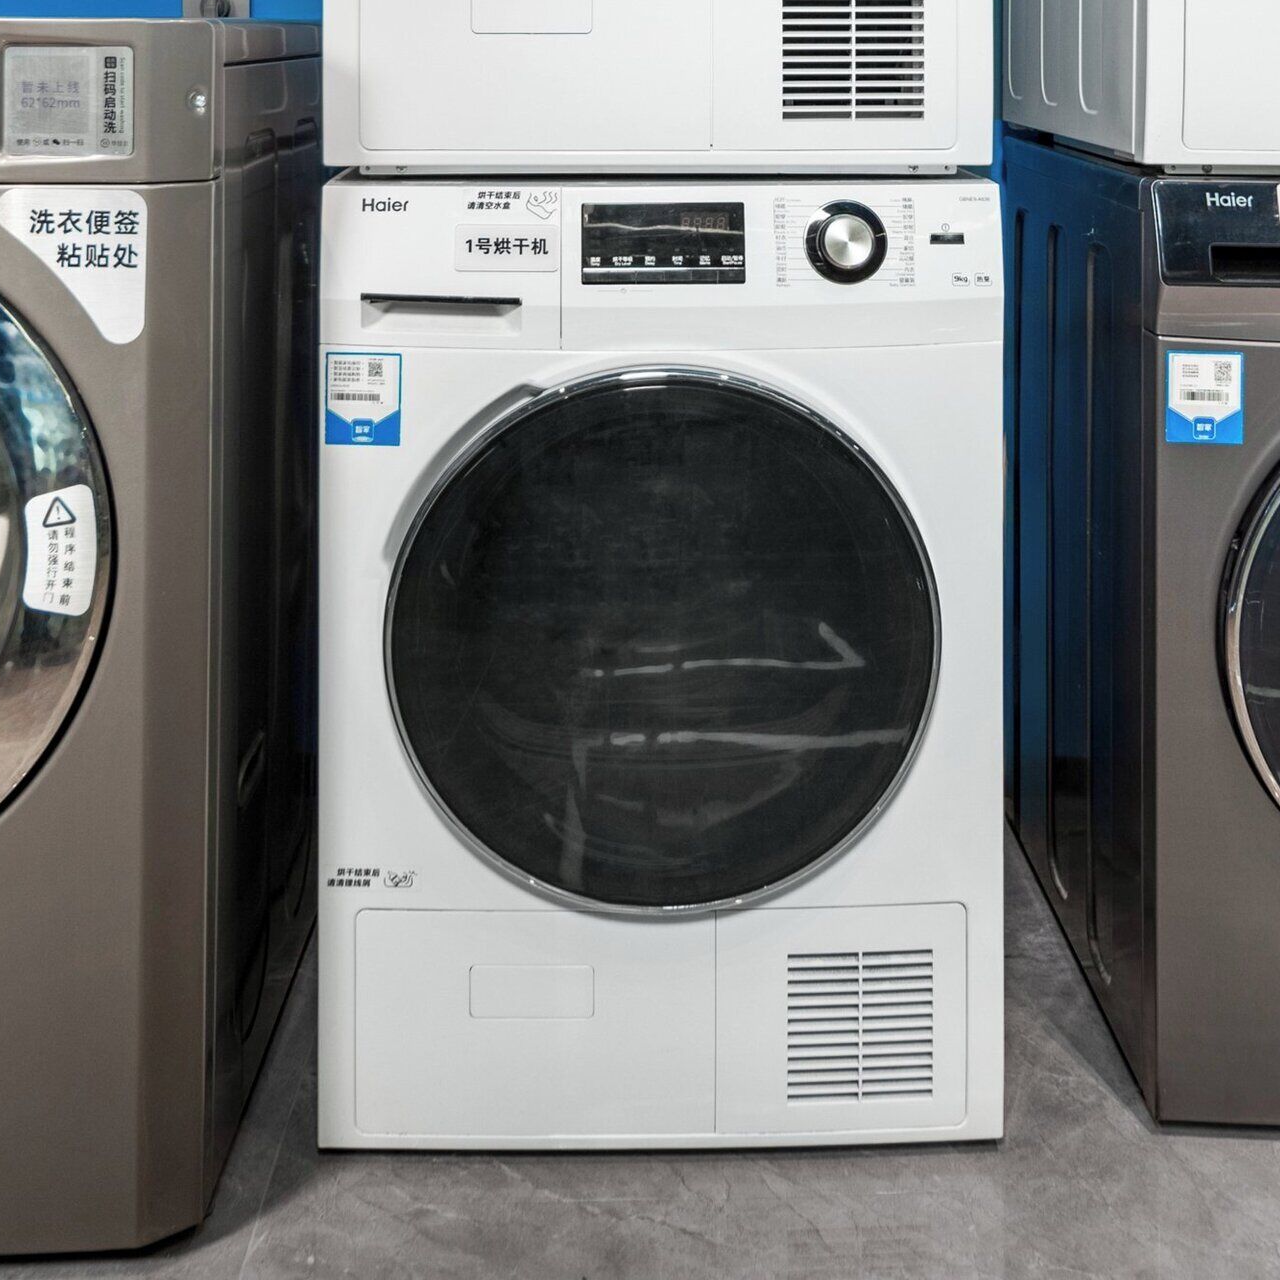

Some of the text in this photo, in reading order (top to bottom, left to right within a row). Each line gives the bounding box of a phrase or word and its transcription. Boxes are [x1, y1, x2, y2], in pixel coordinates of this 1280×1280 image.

[22, 81, 80, 94] 暂未上线
[104, 71, 116, 134] 扫码启动洗
[478, 191, 520, 200] 烘干结束后
[1206, 192, 1253, 208] Haier
[362, 198, 409, 212] Haier
[467, 202, 510, 210] 请清空水盒
[29, 209, 139, 235] 洗衣便签
[465, 238, 549, 255] 1号烘干机
[56, 243, 138, 269] 粘贴处
[954, 276, 968, 284] 9kg
[43, 530, 59, 604] 请勿强行开门
[59, 527, 76, 607] 程序结束前
